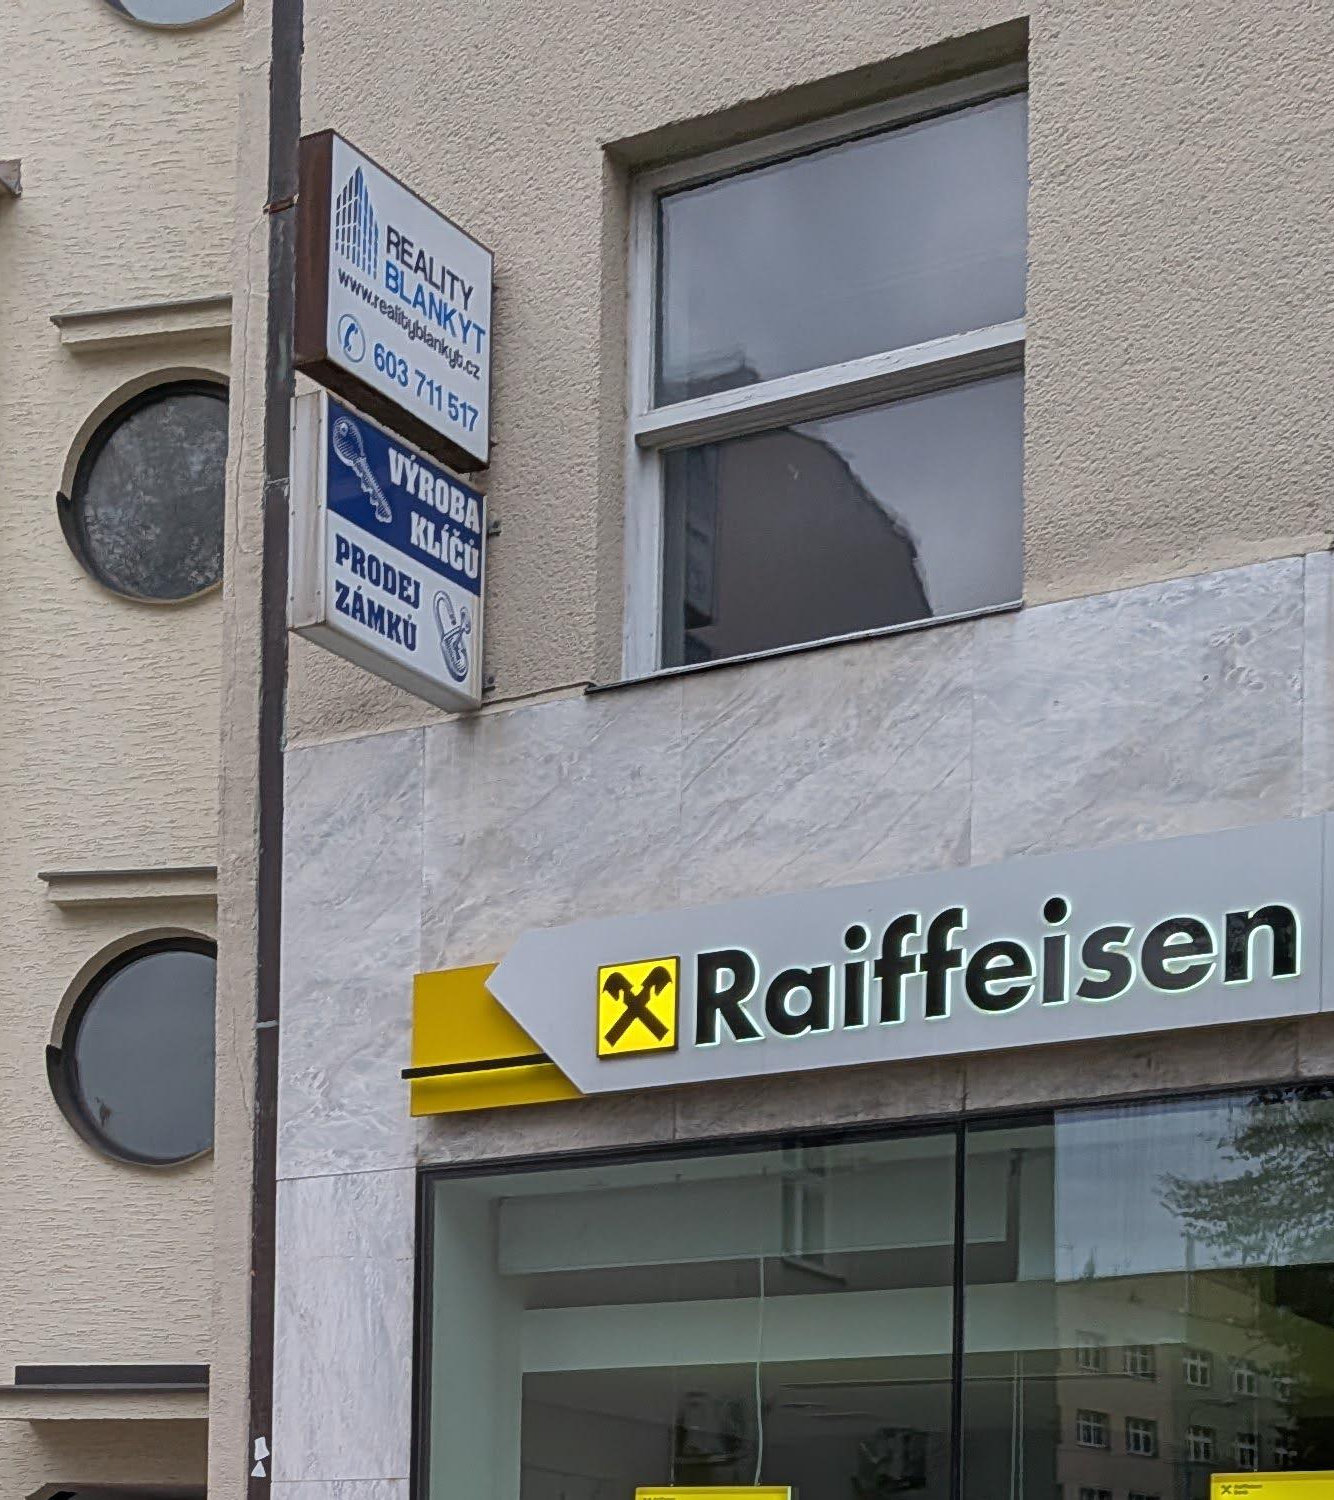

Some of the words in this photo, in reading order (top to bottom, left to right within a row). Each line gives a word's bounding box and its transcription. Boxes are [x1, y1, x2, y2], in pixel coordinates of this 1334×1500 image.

[385, 260, 486, 354] BLANKYT
[387, 225, 474, 311] REALITY
[338, 268, 480, 380] www.realityblankyt.cz
[374, 343, 409, 387] 603
[415, 369, 442, 411] 711
[448, 392, 479, 431] 517
[388, 447, 480, 534] VÝROBA
[335, 533, 421, 610] PRODEJ
[411, 511, 479, 579] KLÍČŮ
[335, 580, 417, 652] ZÁMKŮ
[694, 896, 1301, 1048] Raiffeisen
